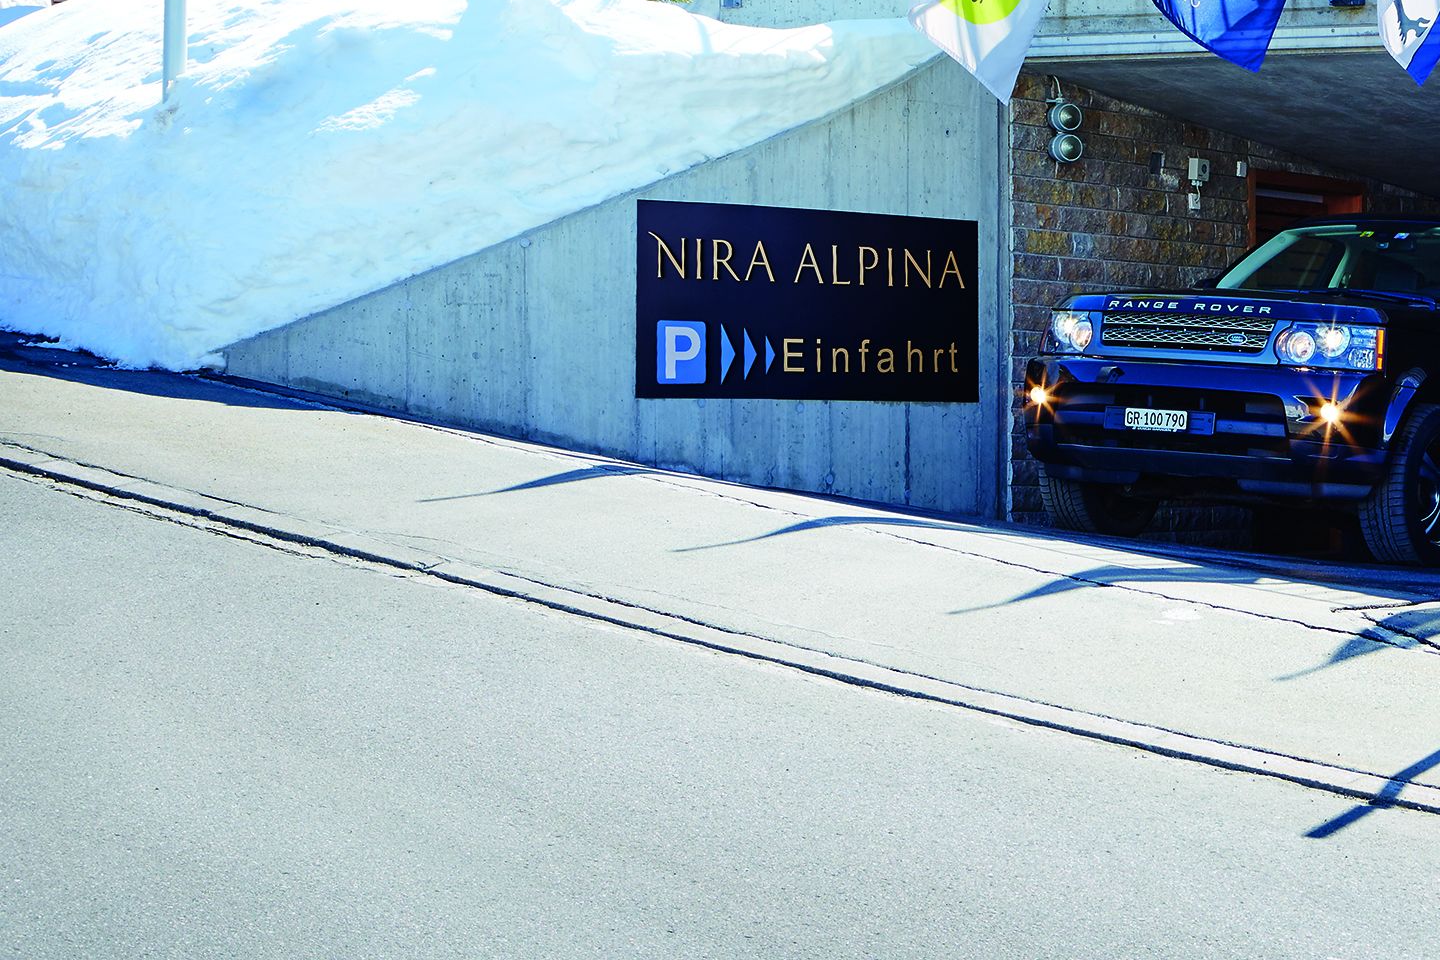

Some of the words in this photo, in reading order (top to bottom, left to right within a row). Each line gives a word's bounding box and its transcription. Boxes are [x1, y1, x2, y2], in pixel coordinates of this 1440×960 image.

[648, 231, 775, 283] NIRA
[793, 242, 966, 290] ALPINA
[1108, 300, 1179, 309] RANGE
[1193, 302, 1272, 314] ROVER
[664, 325, 702, 380] P
[783, 338, 959, 373] Einfahrt
